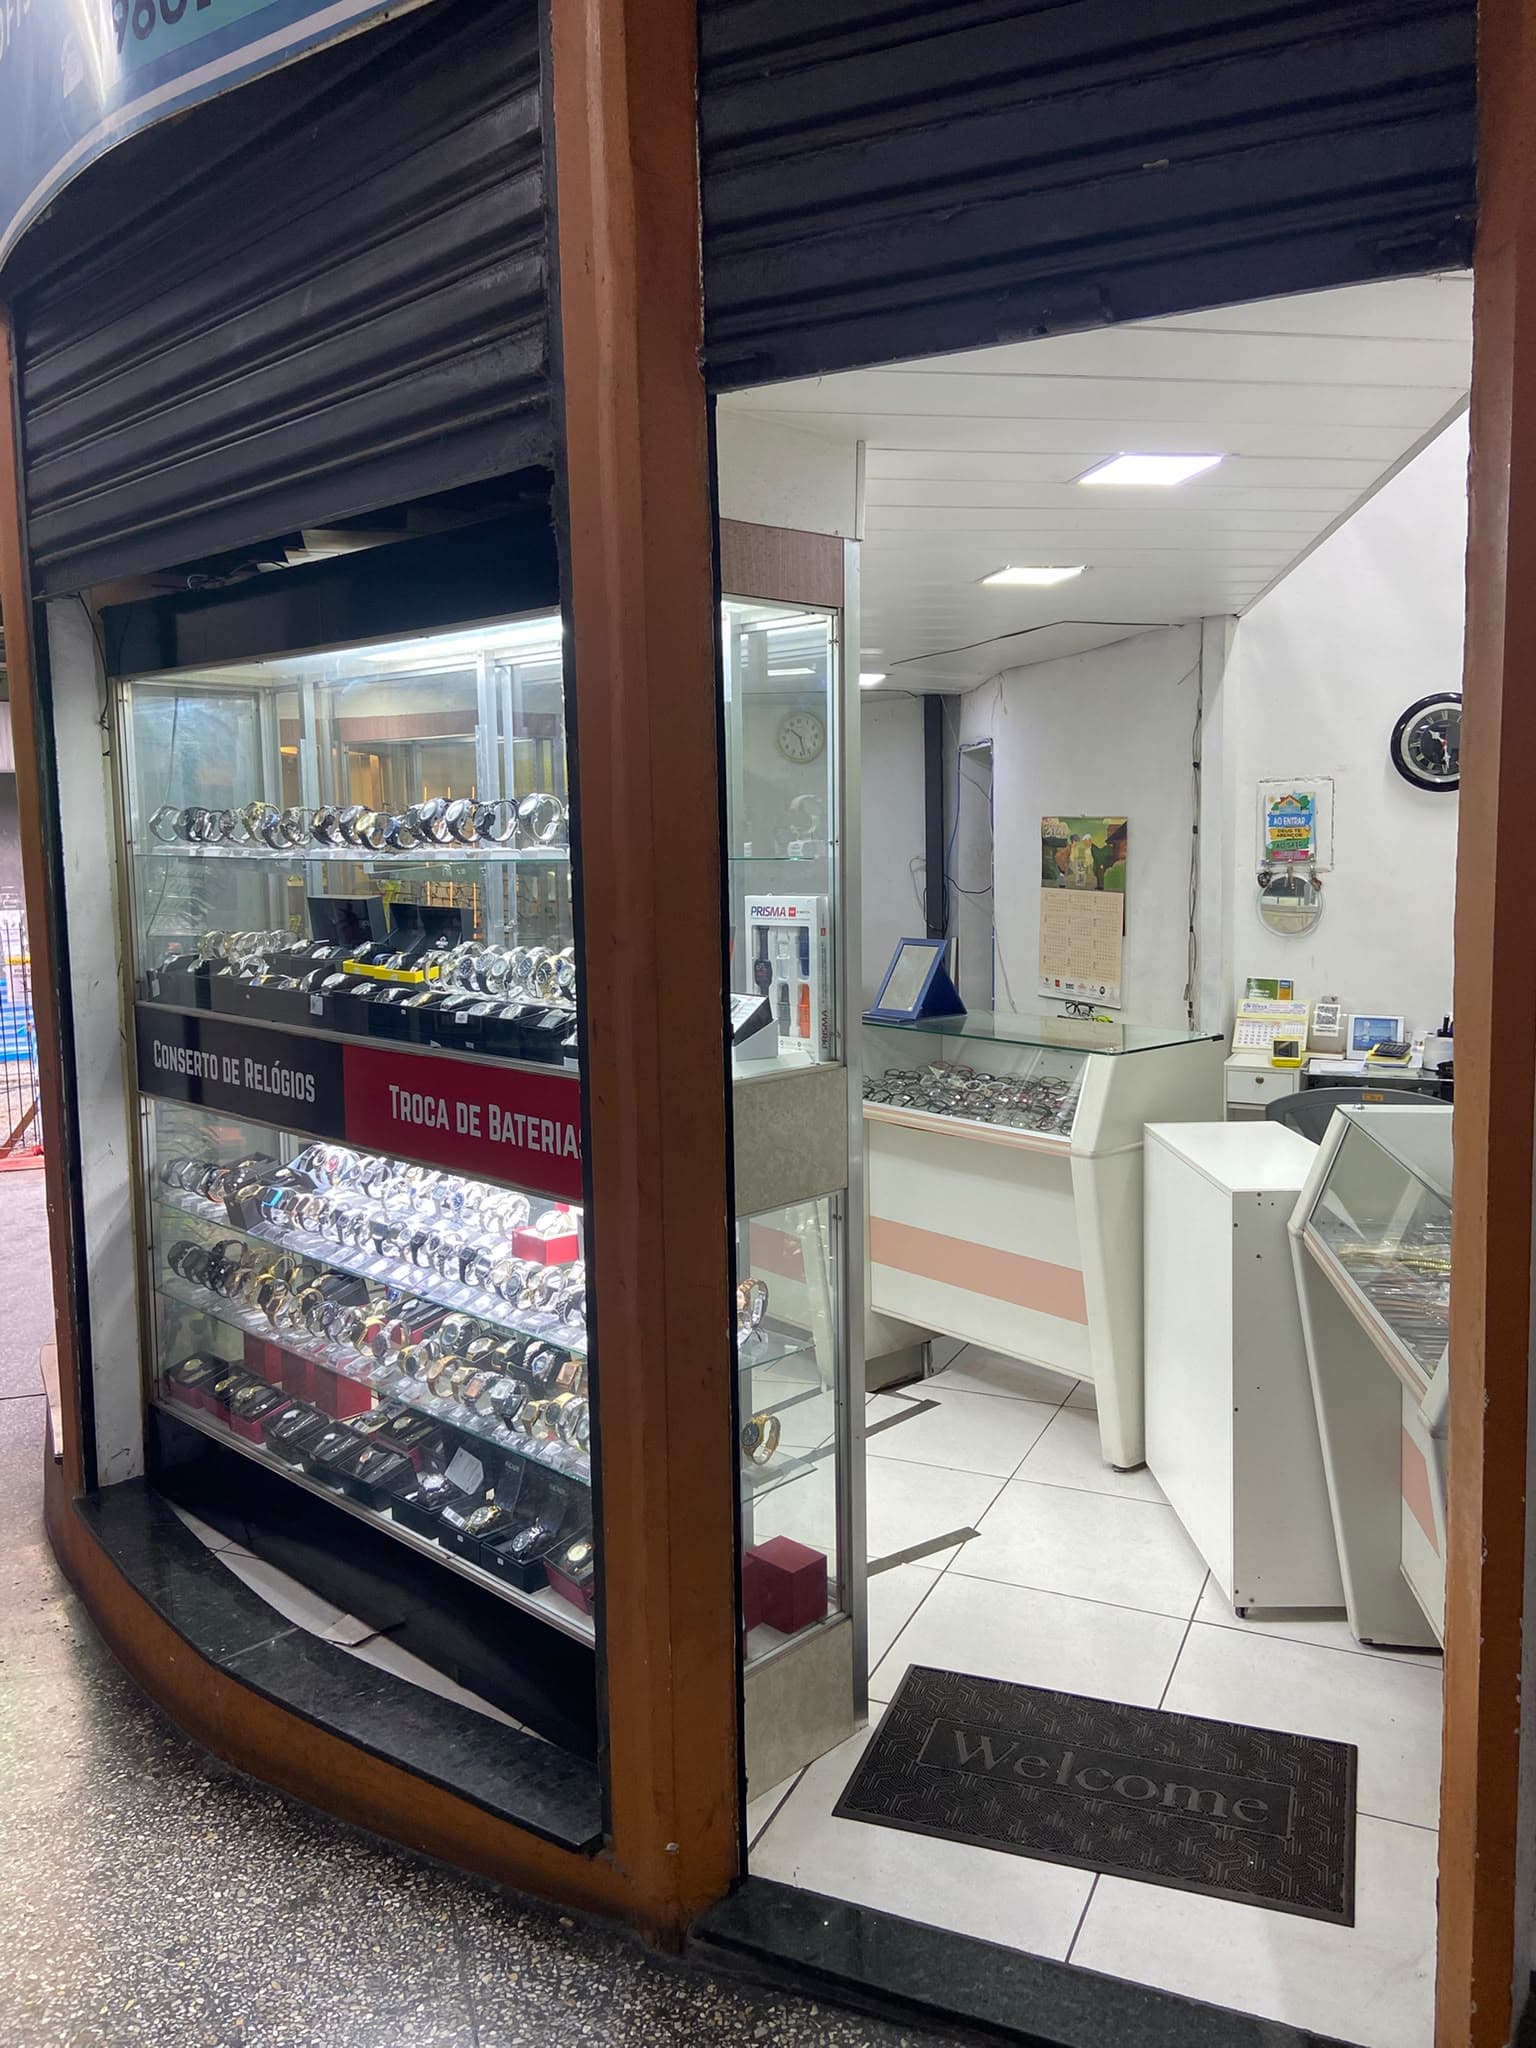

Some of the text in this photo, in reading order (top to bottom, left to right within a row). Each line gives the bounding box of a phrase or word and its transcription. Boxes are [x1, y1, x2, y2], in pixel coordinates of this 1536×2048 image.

[1283, 816, 1306, 825] ENTRAR
[751, 906, 786, 917] PRISMA
[952, 1729, 1270, 1823] Welcome
